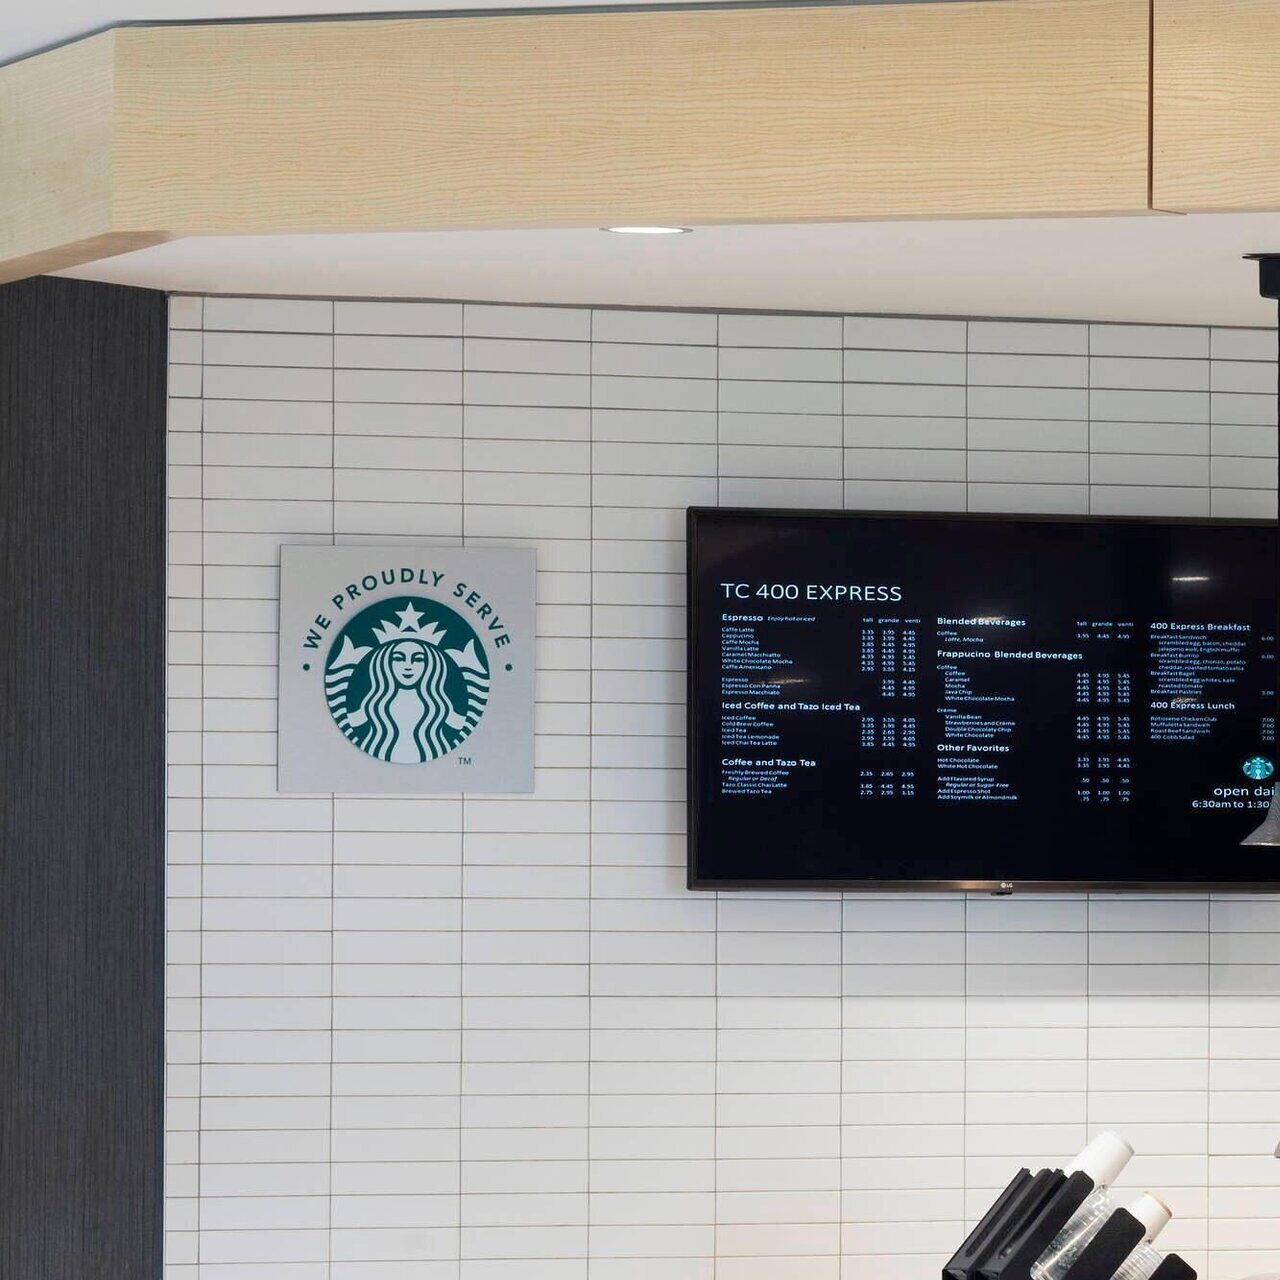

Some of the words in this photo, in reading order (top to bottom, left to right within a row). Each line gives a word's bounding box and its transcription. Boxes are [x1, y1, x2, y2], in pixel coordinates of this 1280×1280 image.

[720, 583, 750, 599] TC
[755, 583, 799, 600] 400
[806, 584, 902, 602] EXPRESS
[303, 614, 332, 650] WE
[332, 568, 445, 610] PROUDLY
[452, 583, 511, 648] SERVE
[722, 613, 764, 622] Espresso
[937, 617, 976, 626] Blended
[978, 618, 1026, 627] Beverages
[1170, 623, 1205, 631] Express
[1207, 623, 1251, 631] Breakfast
[937, 650, 991, 659] Frappucino
[994, 651, 1034, 659] Blended
[1035, 652, 1083, 660] Beverages
[721, 702, 742, 710] Iced
[744, 702, 775, 710] Coffee
[777, 702, 796, 710] and
[821, 703, 842, 711] Iced
[843, 703, 861, 711] Tea
[1170, 702, 1205, 710] Express
[1207, 702, 1235, 710] Lunch
[937, 744, 964, 752] Other
[967, 744, 1010, 752] Favorites
[458, 757, 472, 765] TM
[721, 758, 753, 766] Coffee
[776, 759, 797, 767] Tazo
[799, 759, 816, 767] Tea
[1214, 787, 1249, 797] open
[1192, 800, 1232, 808] 6:30am
